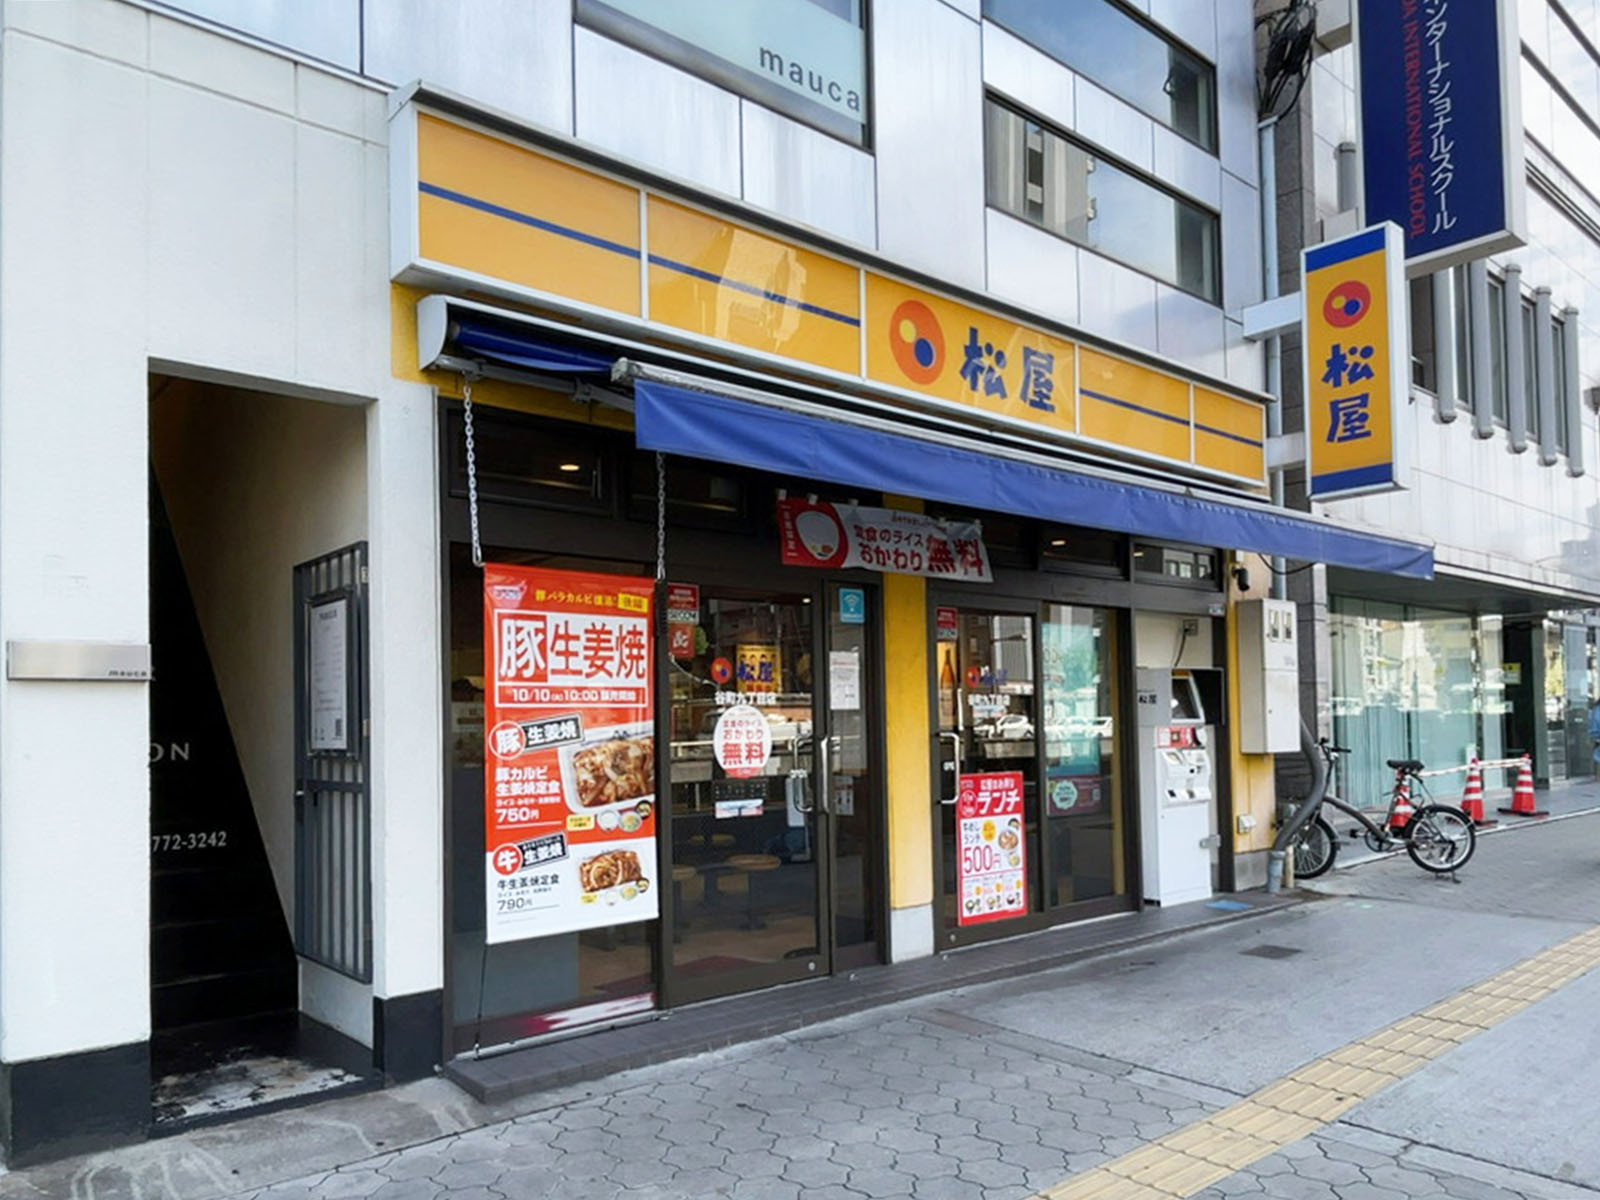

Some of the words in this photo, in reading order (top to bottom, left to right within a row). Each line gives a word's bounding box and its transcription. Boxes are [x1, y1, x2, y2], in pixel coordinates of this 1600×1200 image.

[759, 47, 860, 112] mauca
[1423, 0, 1457, 234] ンターナショナルスクール
[1408, 162, 1426, 238] SCHOOL
[960, 326, 1055, 413] 松屋
[1321, 343, 1375, 443] 松屋
[858, 542, 923, 571] おかわり
[723, 742, 764, 765] 無料
[978, 789, 1020, 815] ランチ
[152, 831, 227, 850] 772-3242
